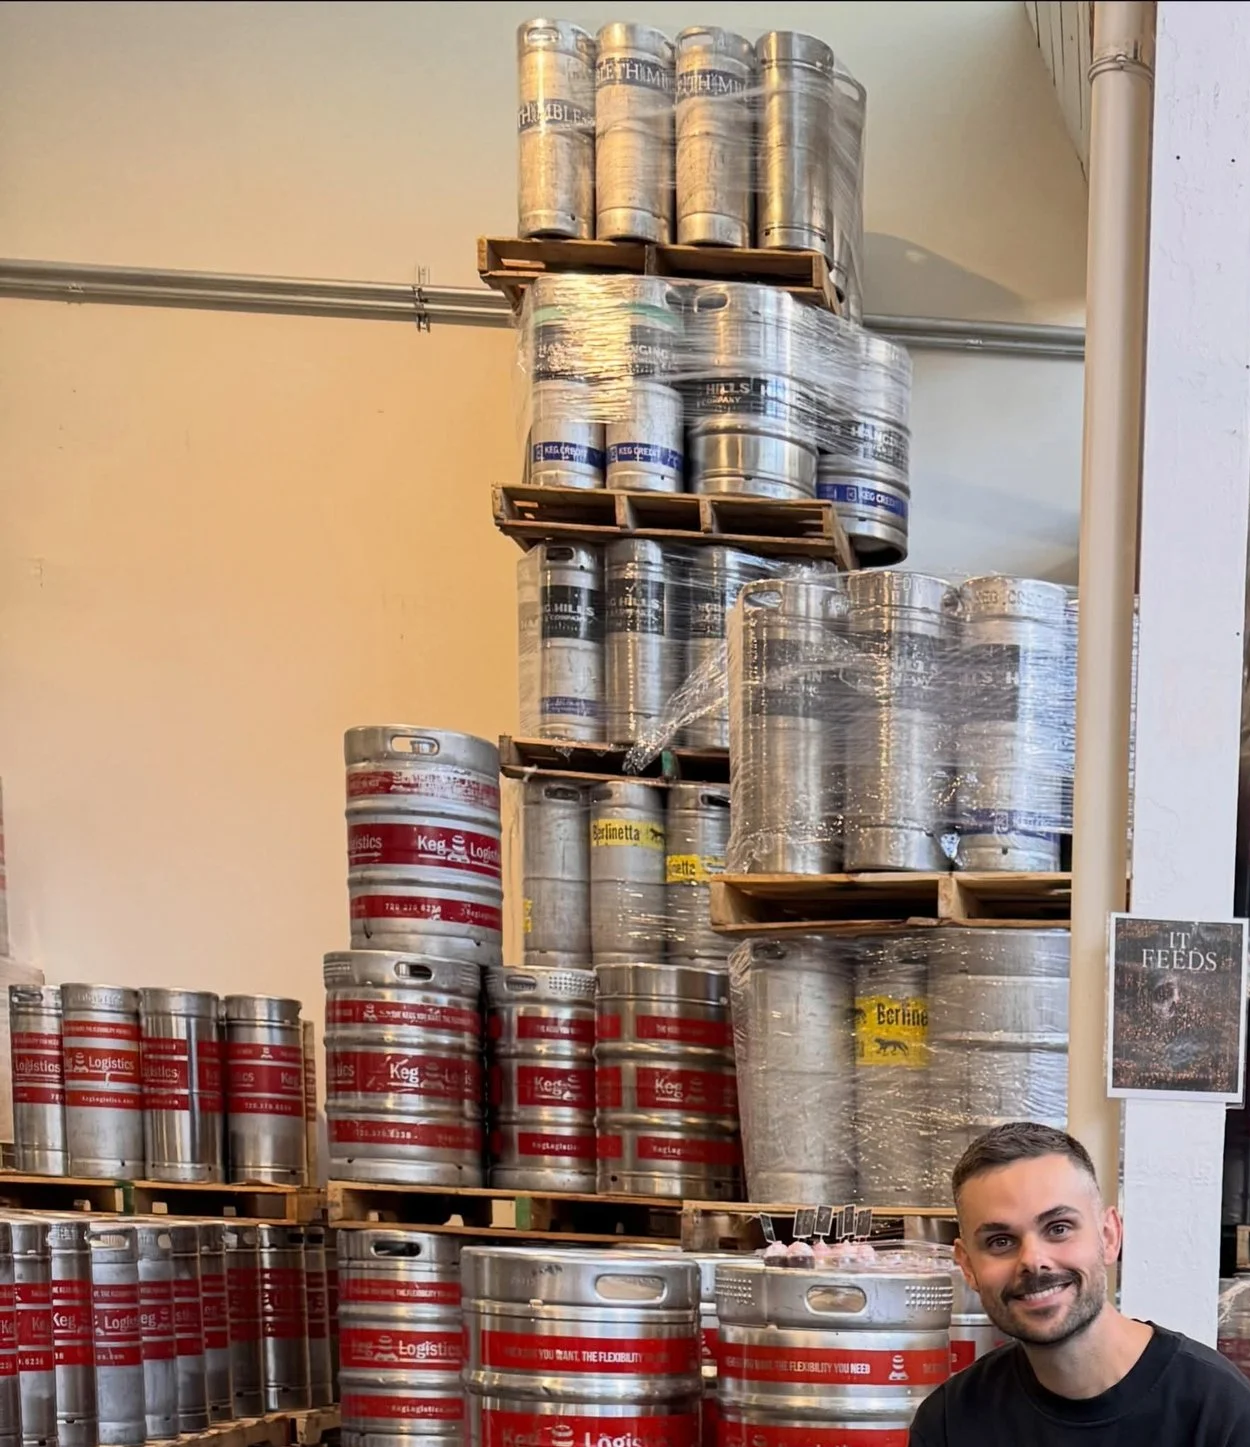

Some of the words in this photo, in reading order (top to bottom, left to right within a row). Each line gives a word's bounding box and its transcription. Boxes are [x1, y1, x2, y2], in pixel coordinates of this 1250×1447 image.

[705, 383, 750, 396] HILLS
[417, 834, 447, 855] Keg
[1168, 931, 1191, 949] IT
[1142, 948, 1218, 972] FEEDS
[88, 1055, 135, 1072] Logistics
[388, 1062, 420, 1085] Keg
[533, 1075, 563, 1096] Keg
[654, 1077, 684, 1098] Keg
[398, 1339, 462, 1359] Logistics
[539, 1349, 553, 1360] YOU
[582, 1351, 598, 1362] THE
[598, 1351, 643, 1364] FLEXIBILITY
[789, 1362, 833, 1373] FLEXIBILITY
[834, 1363, 850, 1374] YOU
[850, 1363, 871, 1375] NEED
